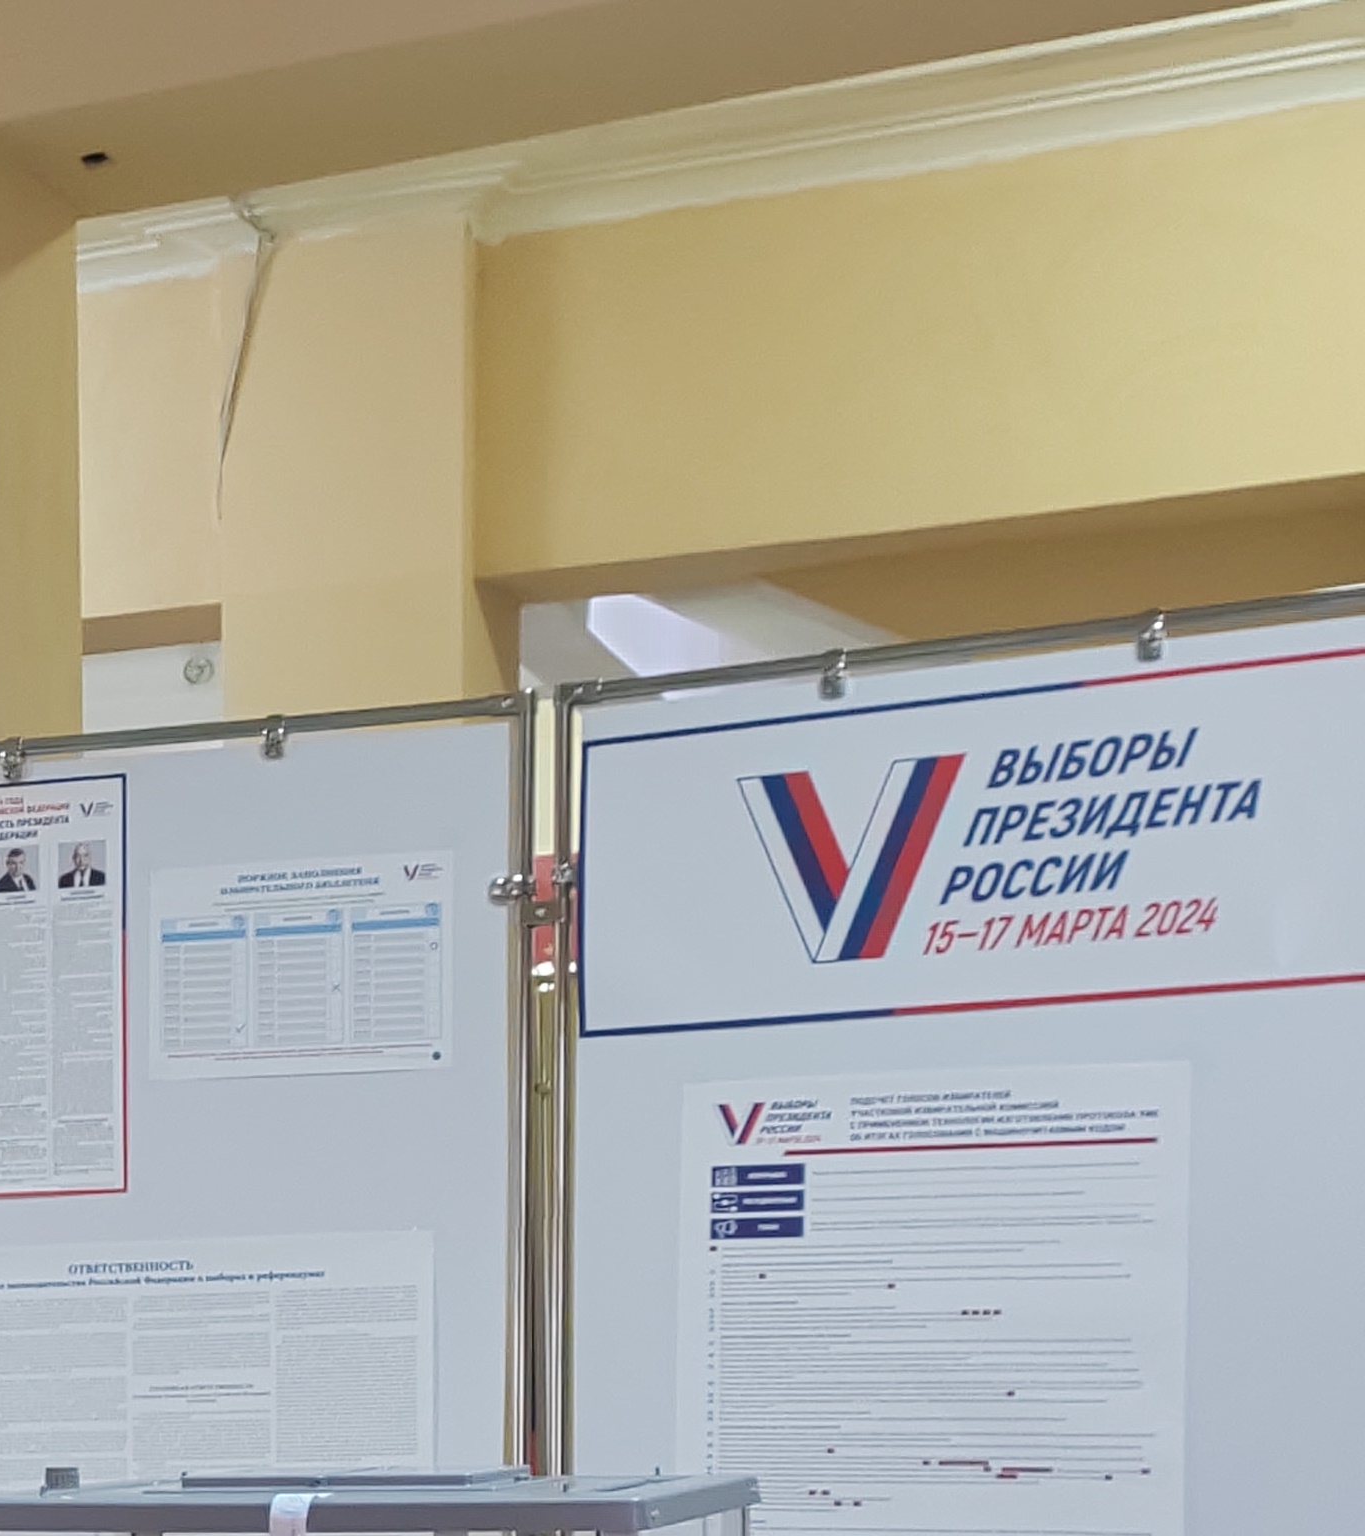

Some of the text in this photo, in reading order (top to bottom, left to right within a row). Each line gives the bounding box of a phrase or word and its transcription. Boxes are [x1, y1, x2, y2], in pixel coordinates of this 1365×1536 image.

[986, 726, 1200, 790] ВЫБОРЫ
[963, 778, 1262, 848] ПРЕЗИДЕНТА
[939, 849, 1130, 905] РОССИИ
[1014, 904, 1129, 948] МАРТА
[1133, 896, 1220, 938] 2024
[69, 1260, 194, 1274] ОТВЕТСТВЕННОСТЬ
